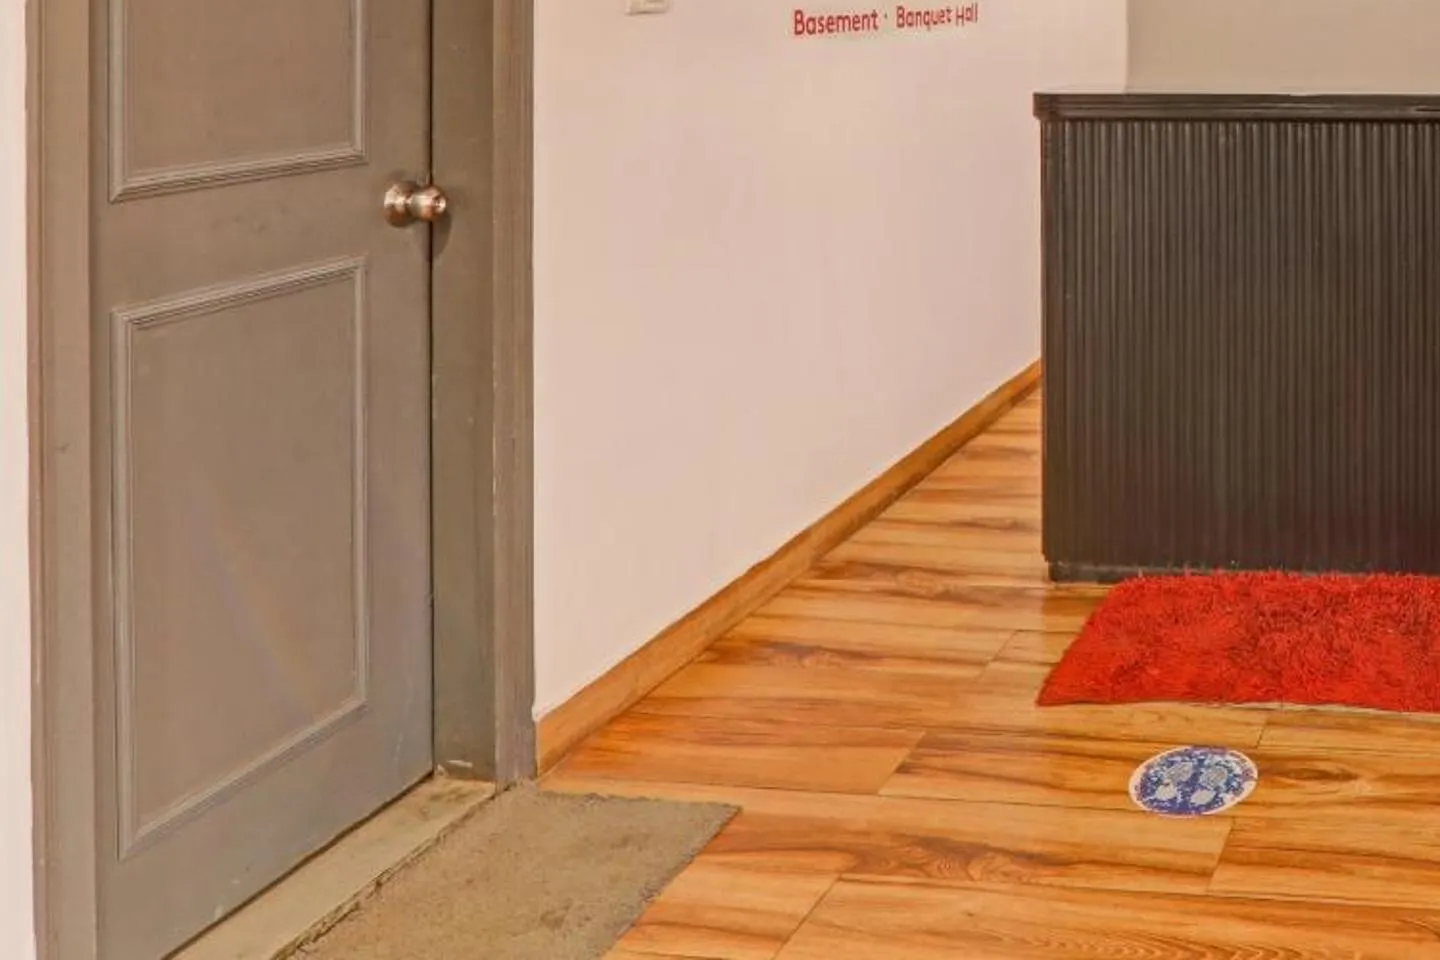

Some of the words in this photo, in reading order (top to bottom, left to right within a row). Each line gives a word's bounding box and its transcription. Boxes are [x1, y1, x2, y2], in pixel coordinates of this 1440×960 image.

[793, 8, 879, 36] Basement
[896, 4, 953, 31] Banquet
[955, 2, 979, 27] Hall
